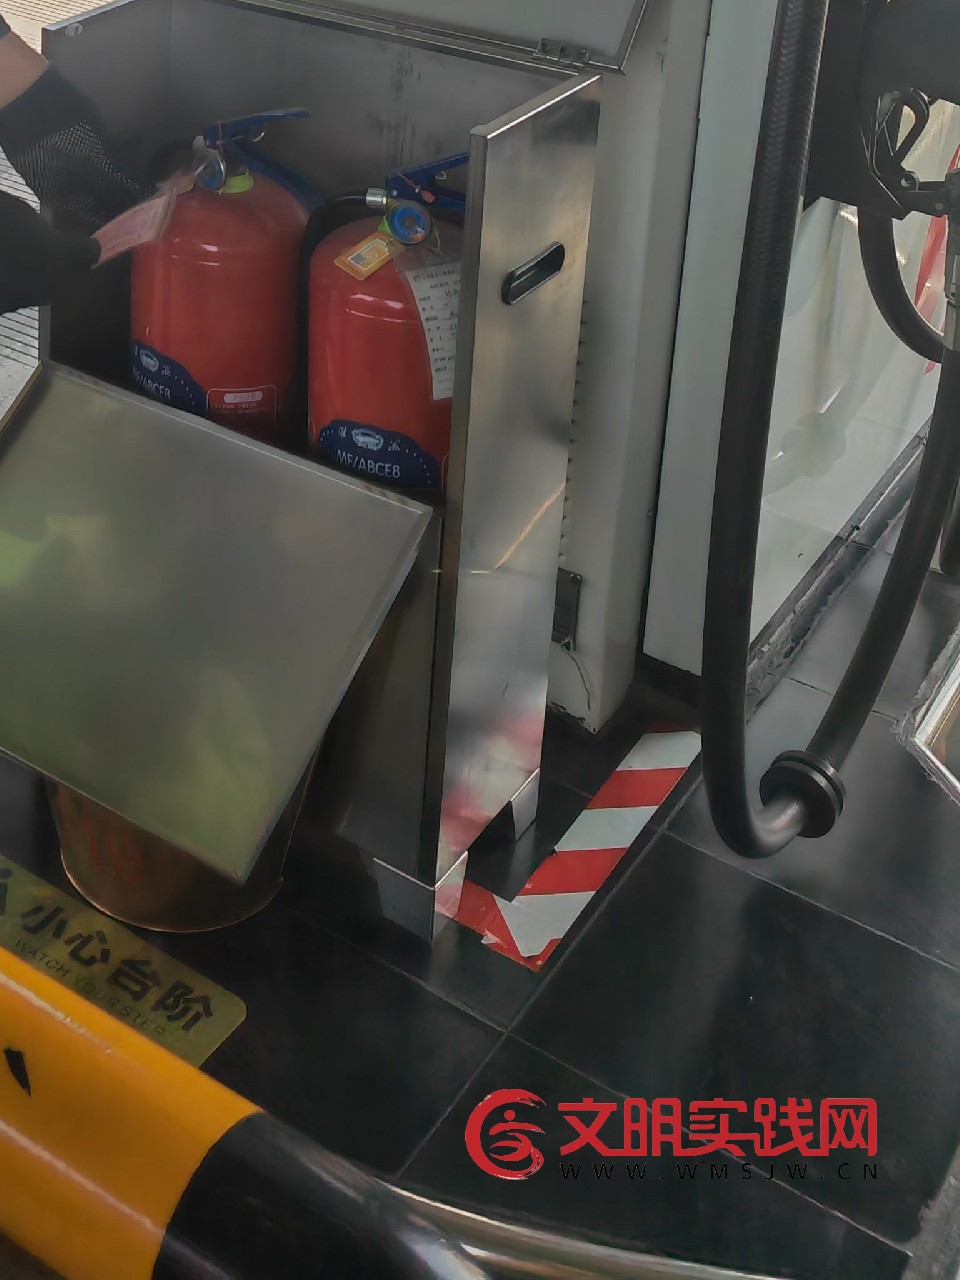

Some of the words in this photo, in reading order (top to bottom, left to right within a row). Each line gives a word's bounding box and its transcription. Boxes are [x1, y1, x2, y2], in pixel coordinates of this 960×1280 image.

[15, 939, 71, 978] WATCH
[75, 974, 120, 1009] YOUR
[20, 905, 214, 1032] 小心台阶
